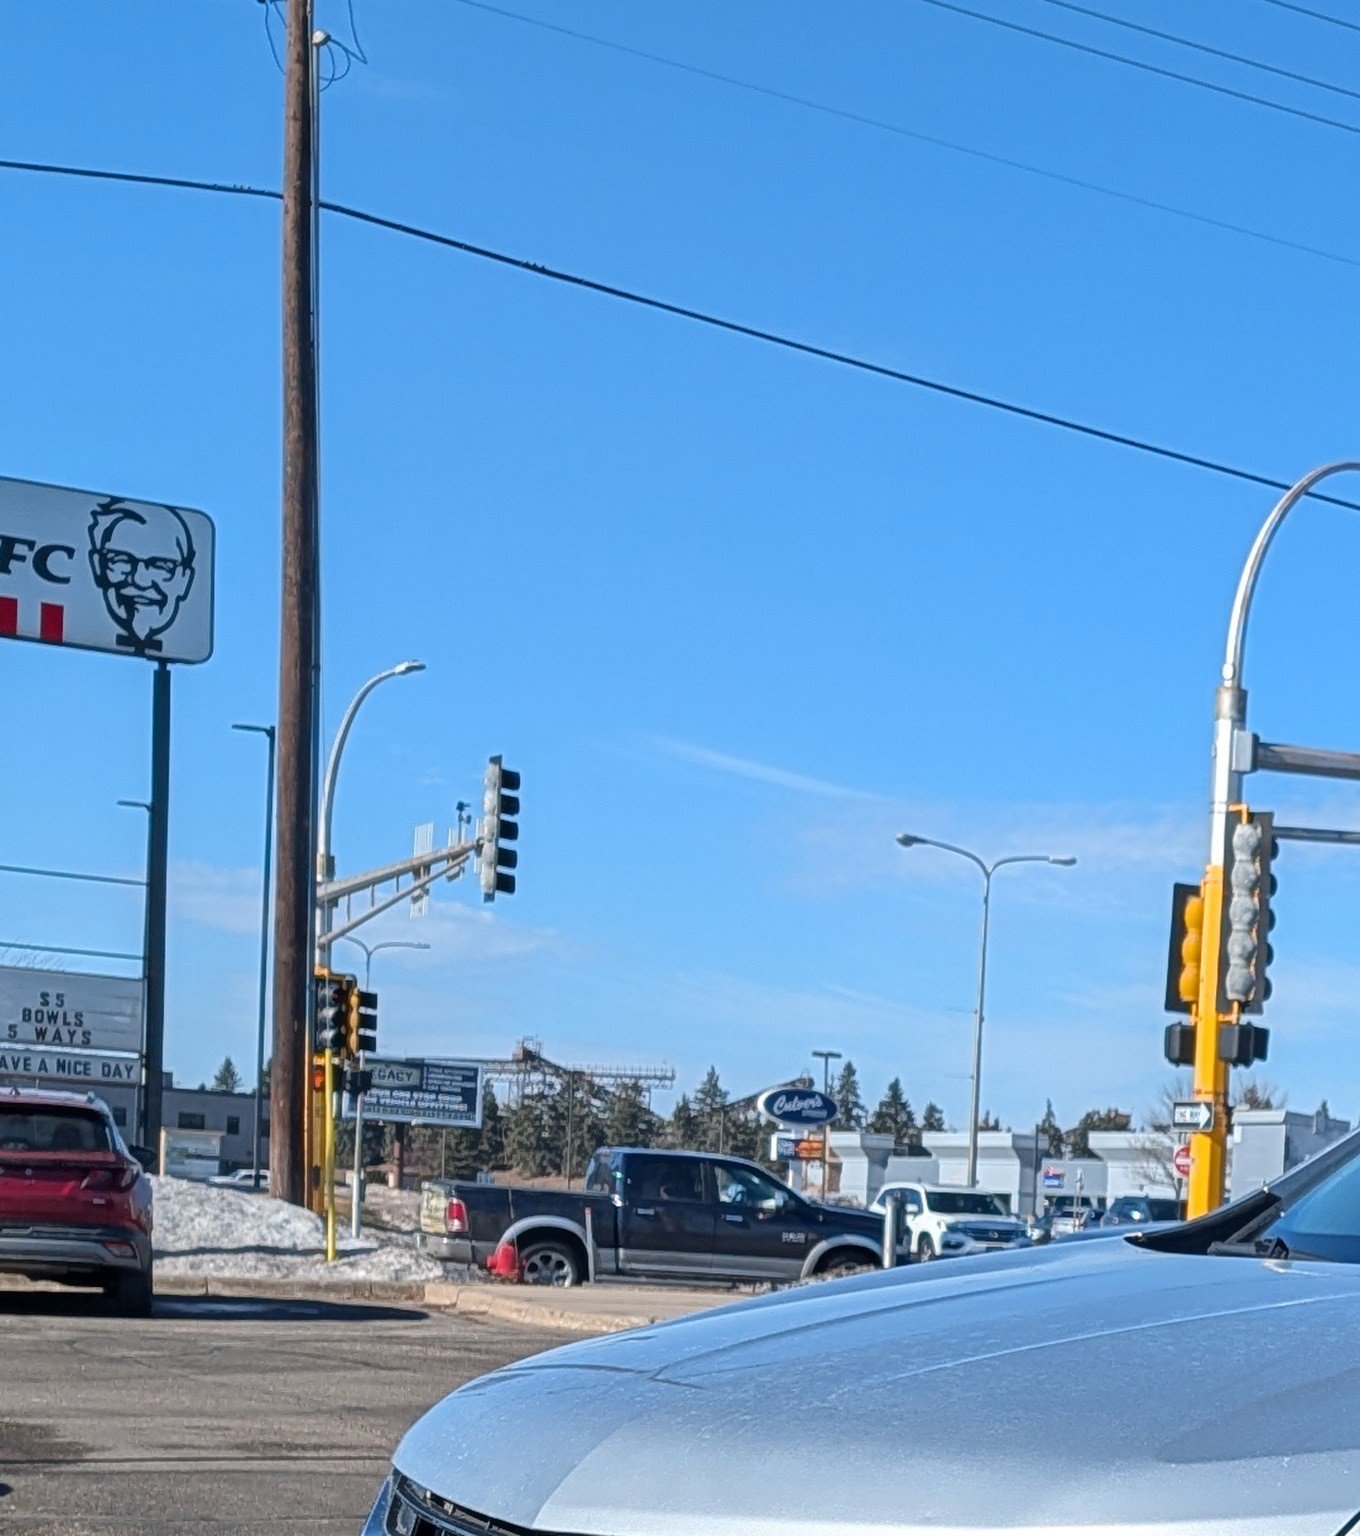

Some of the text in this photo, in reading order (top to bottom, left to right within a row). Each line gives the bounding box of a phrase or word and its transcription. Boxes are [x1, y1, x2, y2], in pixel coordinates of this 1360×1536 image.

[0, 534, 76, 585] FC
[21, 1007, 84, 1028] BOWLS
[7, 1023, 92, 1045] 5 WAYS
[0, 1055, 134, 1079] AVE A NICE DAY
